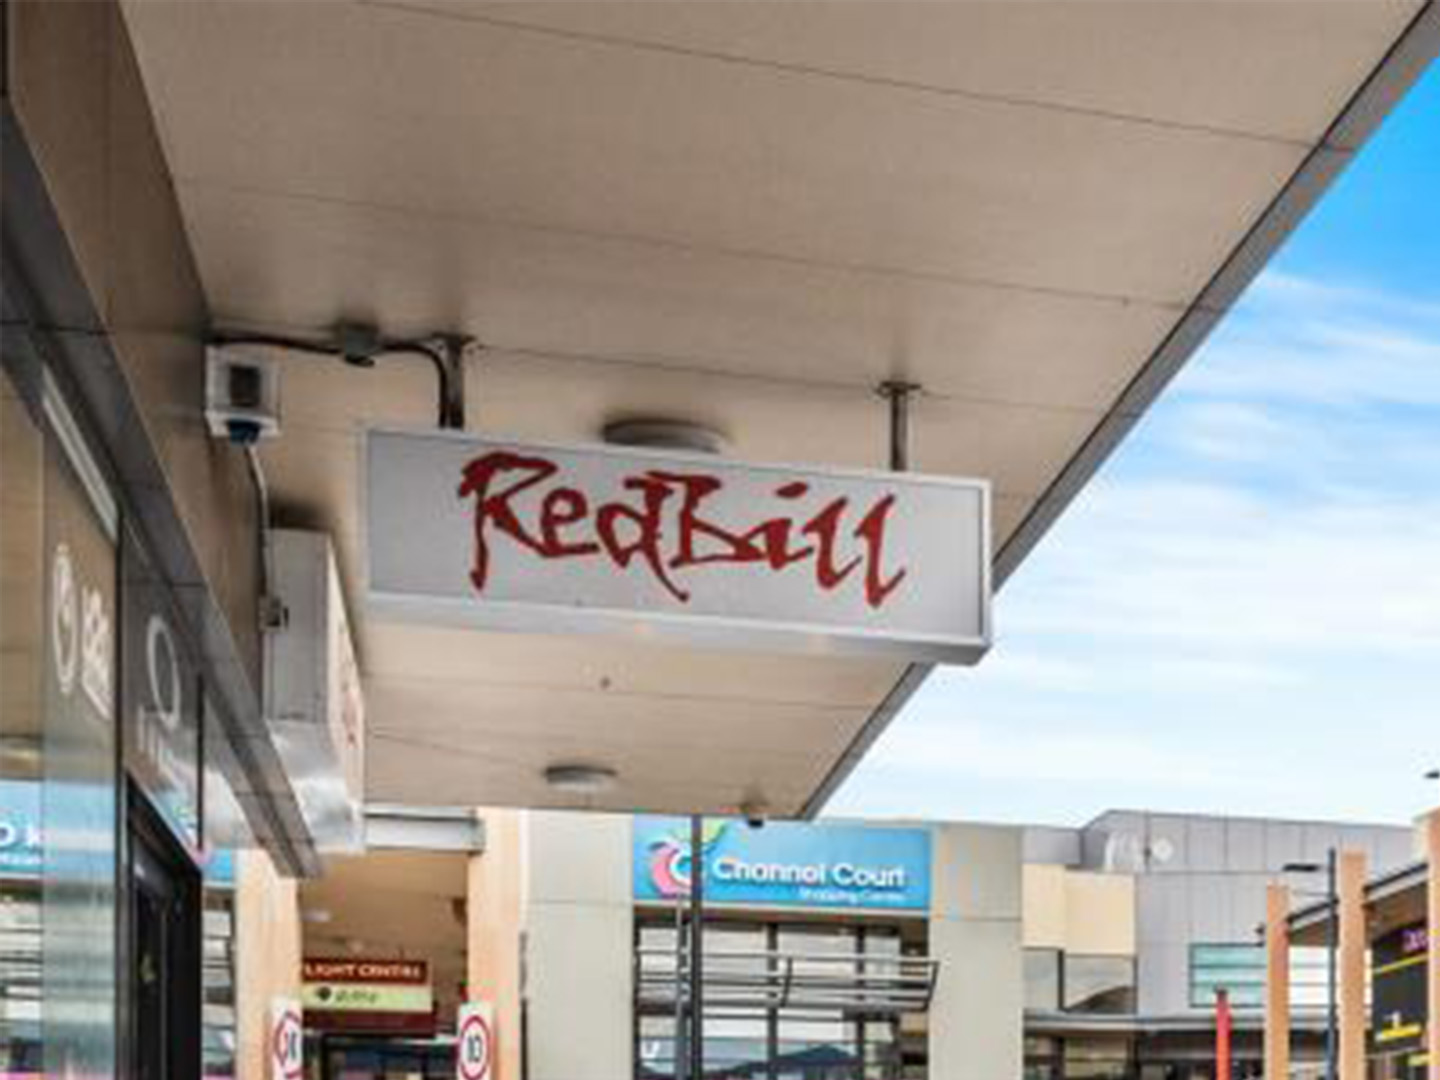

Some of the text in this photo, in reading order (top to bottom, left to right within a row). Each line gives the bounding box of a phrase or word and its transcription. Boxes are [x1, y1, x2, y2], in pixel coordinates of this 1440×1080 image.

[458, 451, 907, 608] RedBill
[712, 856, 906, 887] Channel Court
[304, 963, 357, 978] LIGHT
